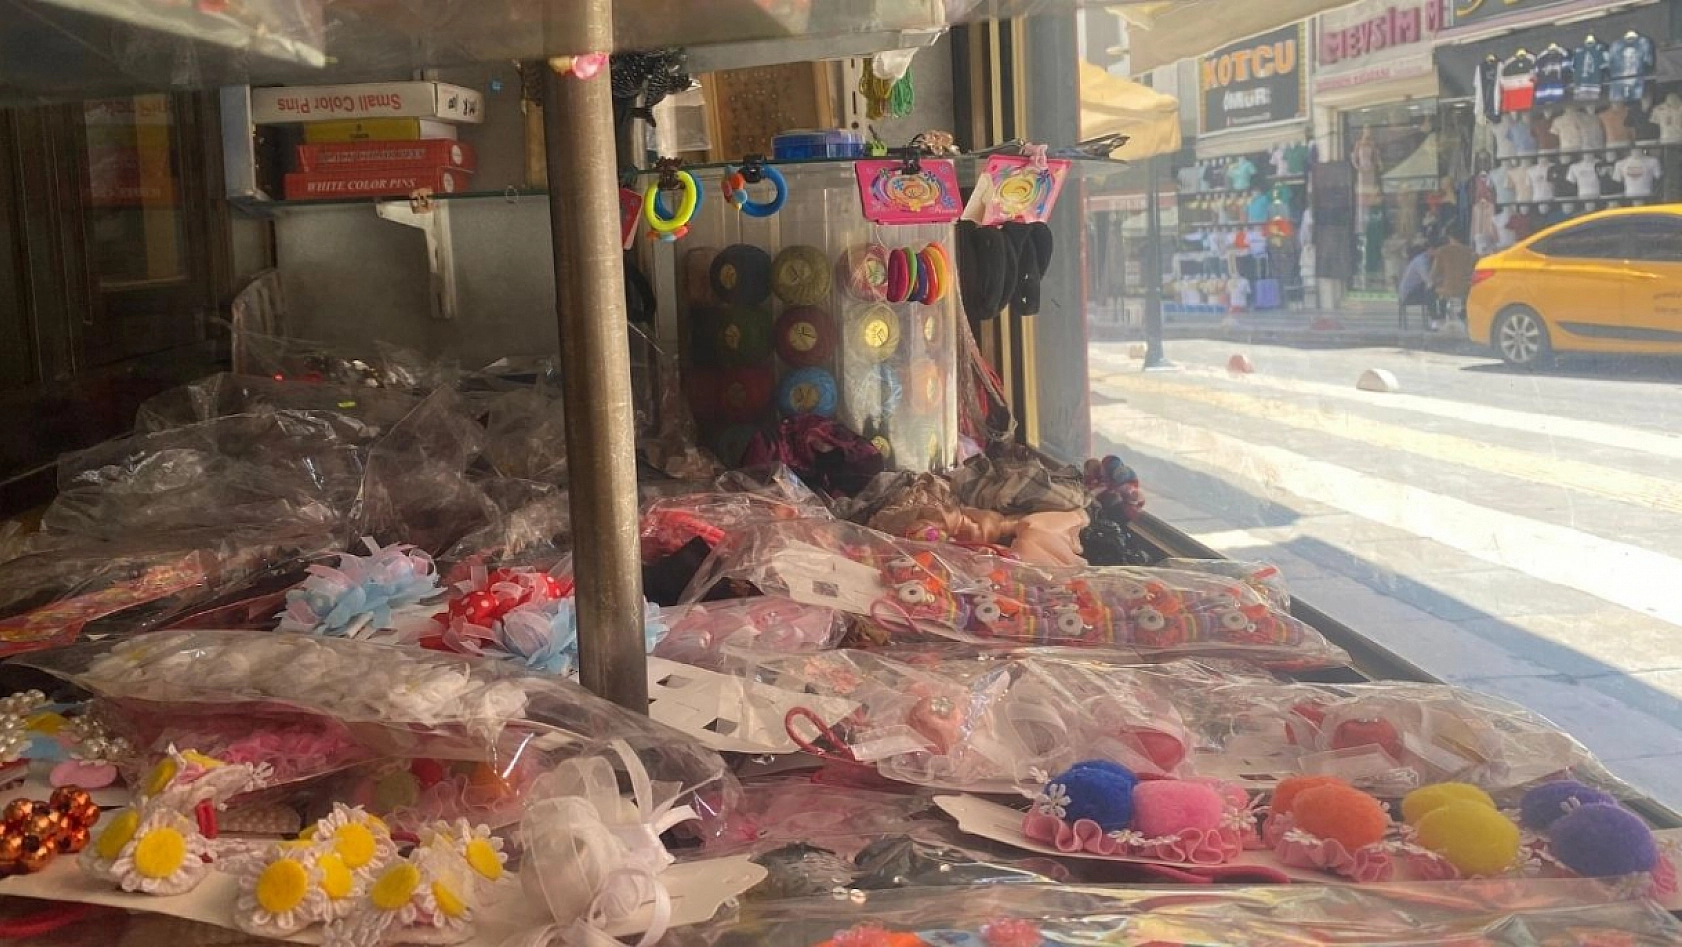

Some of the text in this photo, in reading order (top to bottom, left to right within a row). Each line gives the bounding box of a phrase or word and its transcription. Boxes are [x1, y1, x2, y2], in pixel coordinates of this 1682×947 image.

[277, 93, 402, 114] Small Color Pins
[307, 177, 417, 192] WHITE COLOR PINS
